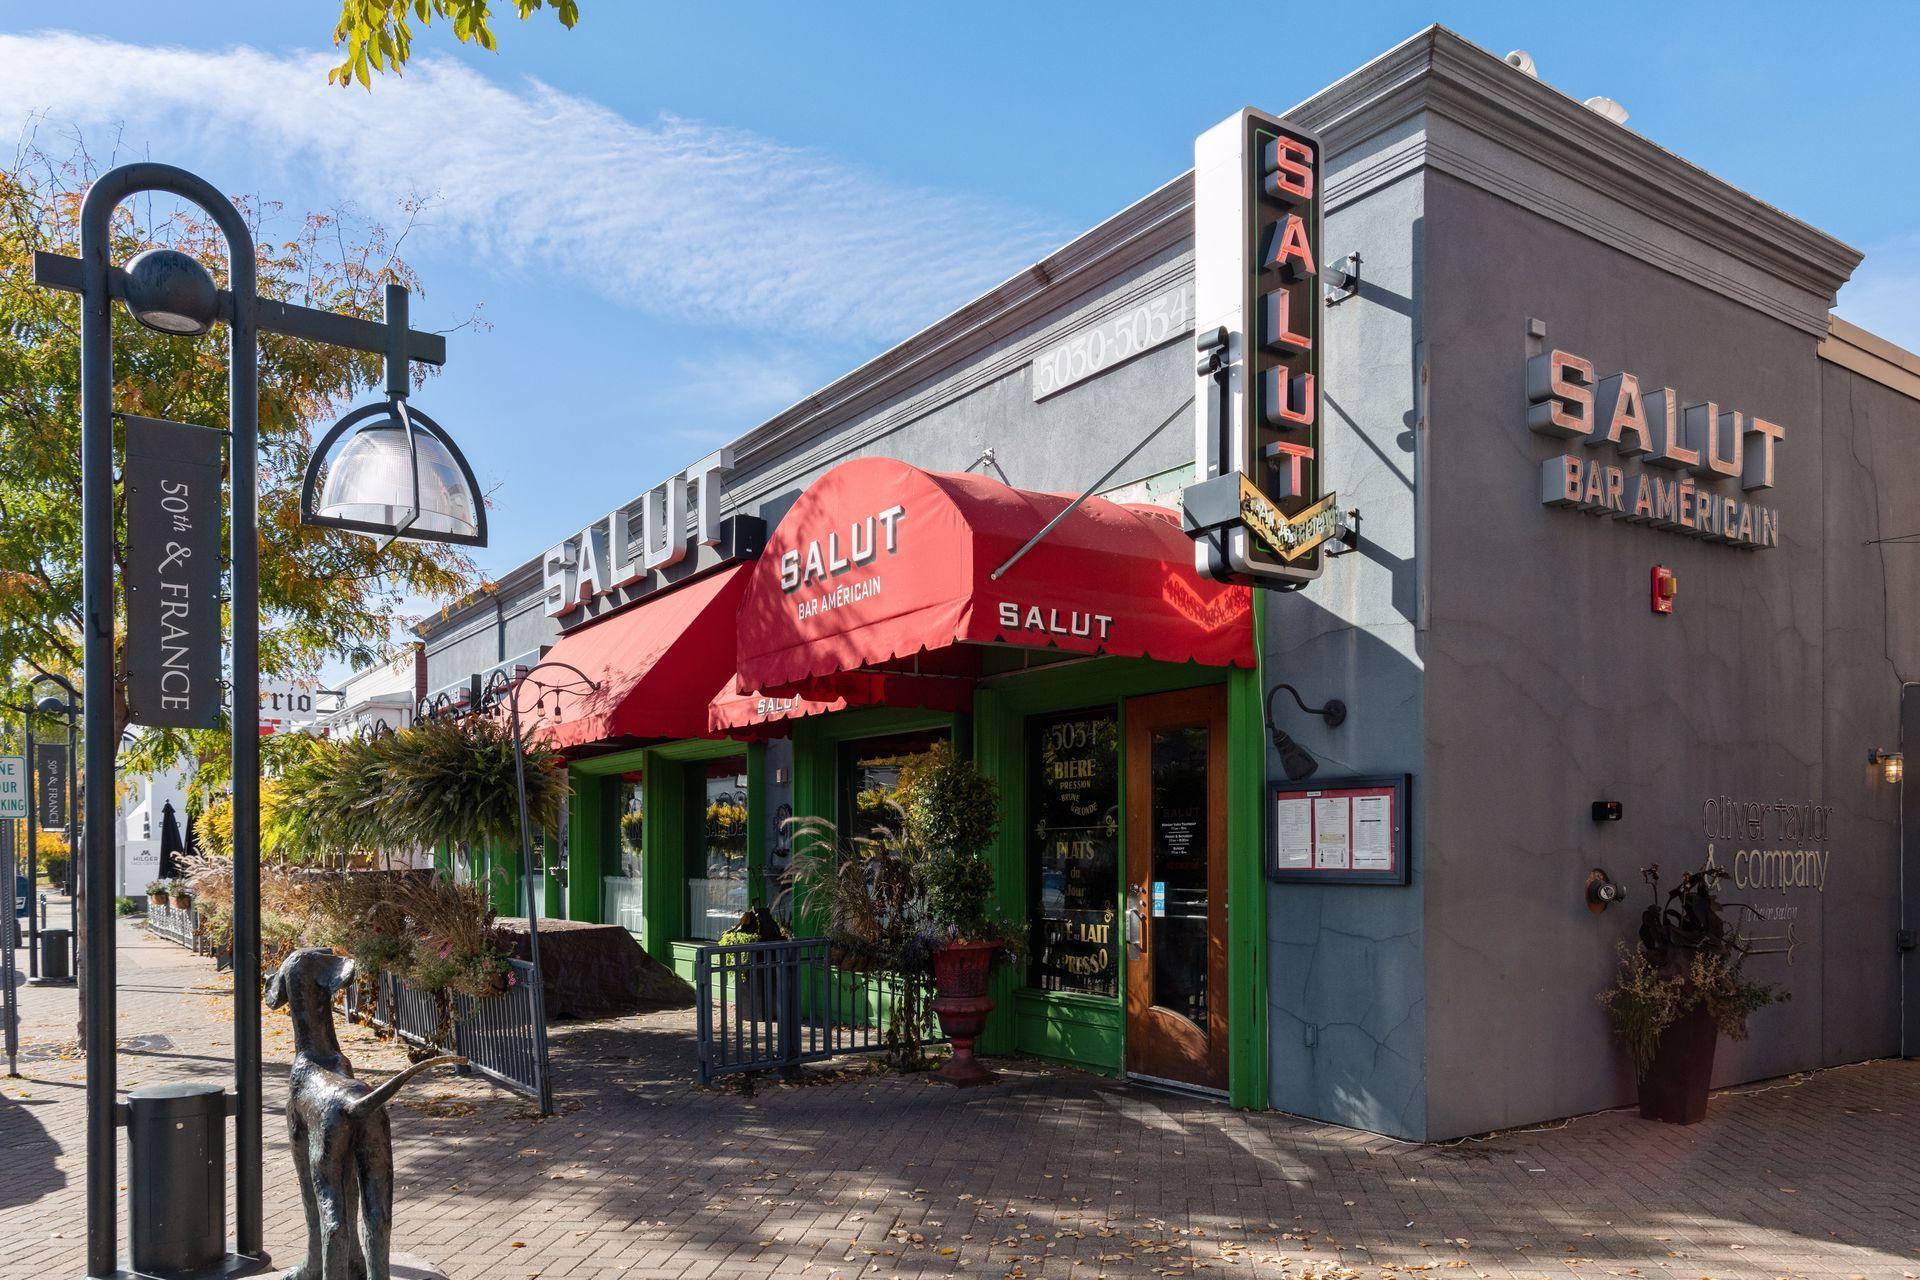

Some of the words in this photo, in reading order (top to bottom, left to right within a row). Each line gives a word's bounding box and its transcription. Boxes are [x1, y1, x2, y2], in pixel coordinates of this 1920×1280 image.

[1264, 135, 1317, 497] SALUT
[1551, 350, 1785, 488] SALUT
[161, 480, 192, 532] 50th
[1563, 454, 1624, 512] BAR
[1635, 473, 1778, 549] AMÉRICAIN
[543, 449, 722, 618] SALUT
[781, 505, 905, 590] SALUT
[158, 541, 191, 574] &
[798, 598, 818, 620] BAR
[821, 576, 881, 613] AMÉRICAIN
[1000, 602, 1112, 638] SALUT
[161, 581, 190, 710] FRANCE
[0, 764, 15, 775] NE
[1054, 757, 1097, 779] BIÈRE
[1060, 780, 1091, 789] PRESSION
[0, 782, 17, 793] UR
[0, 799, 24, 810] KING
[48, 788, 59, 824] FRANCE
[1056, 841, 1095, 860] PLATS
[1735, 850, 1829, 895] company
[1080, 923, 1110, 944] LAIT
